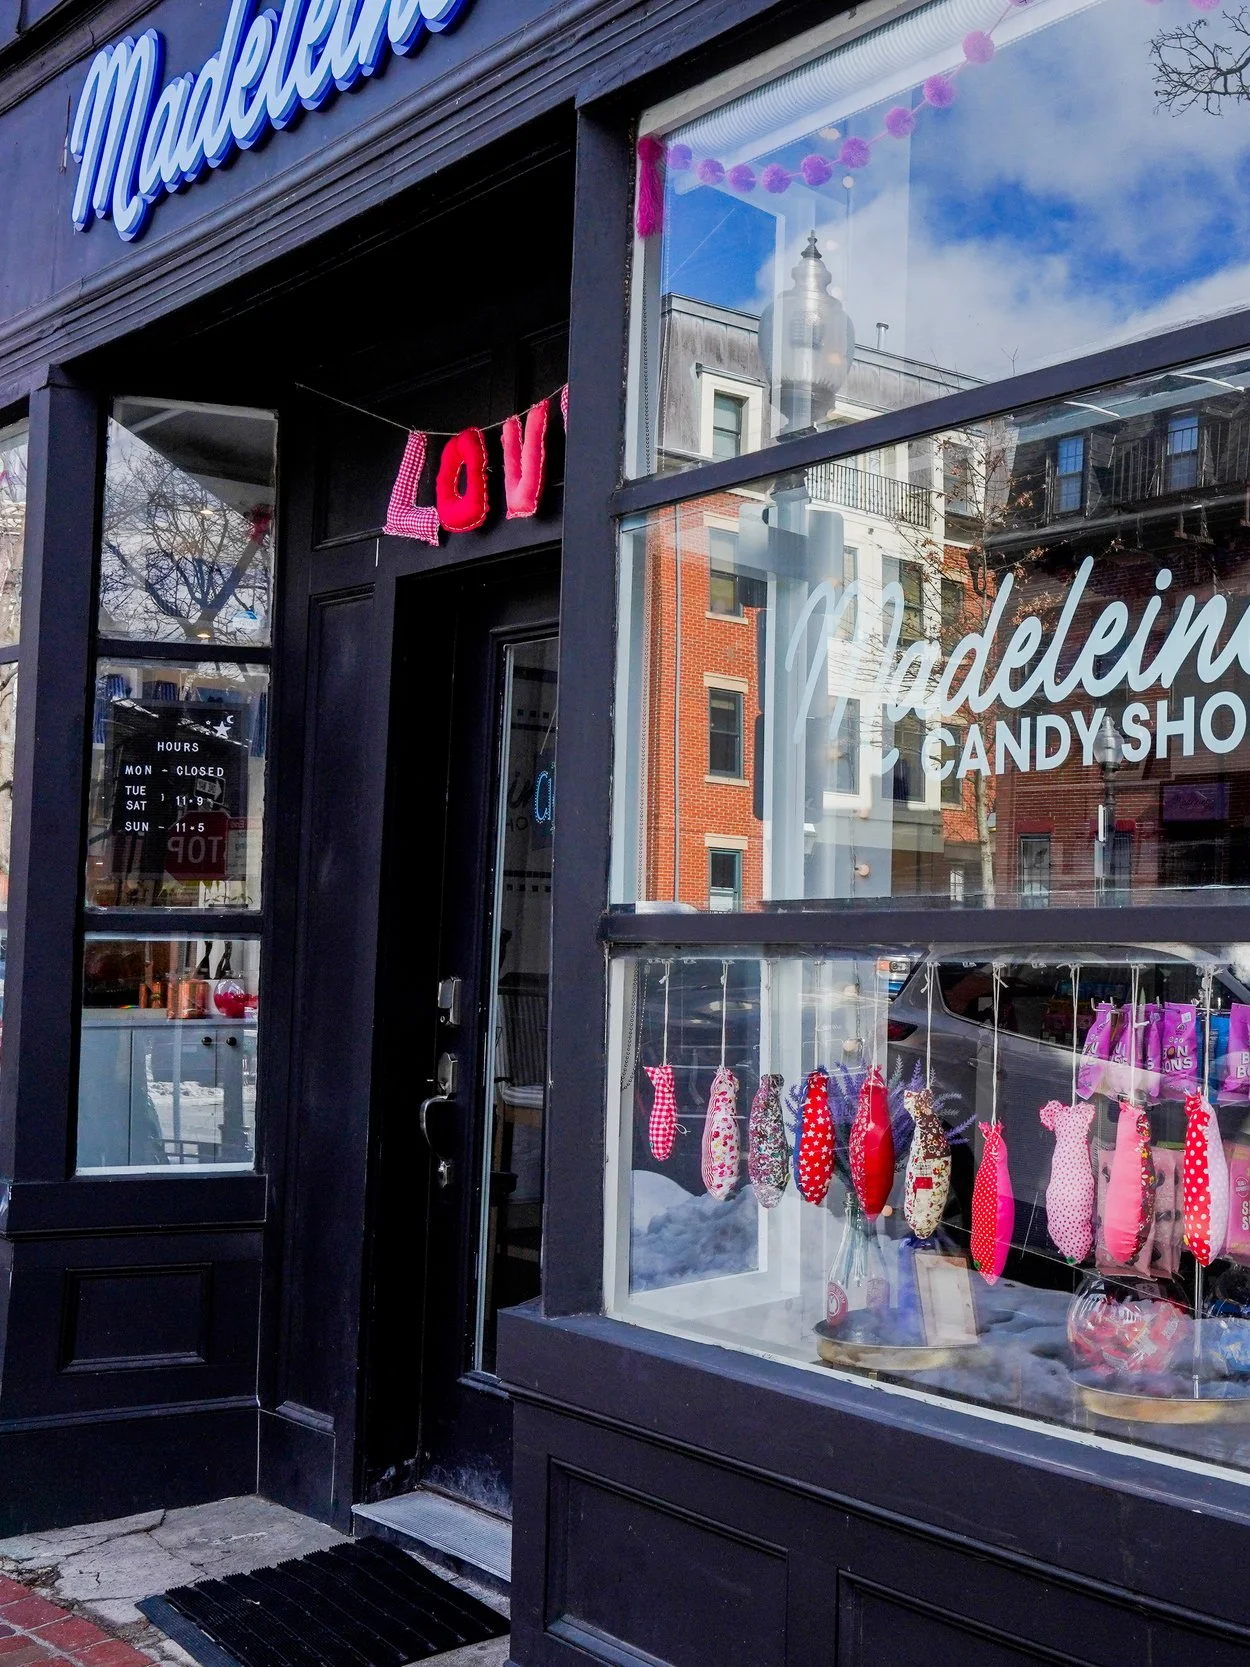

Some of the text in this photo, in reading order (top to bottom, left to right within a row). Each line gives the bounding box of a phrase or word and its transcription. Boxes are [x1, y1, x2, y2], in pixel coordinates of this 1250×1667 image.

[70, 0, 466, 242] Madelein
[382, 382, 568, 546] LOV
[157, 741, 199, 753] HOURS
[921, 706, 1106, 781] CANDY
[124, 764, 152, 776] MON
[176, 765, 224, 777] CLOSED
[124, 785, 147, 796] TUE
[125, 800, 147, 811] SAT
[124, 821, 149, 832] SUN
